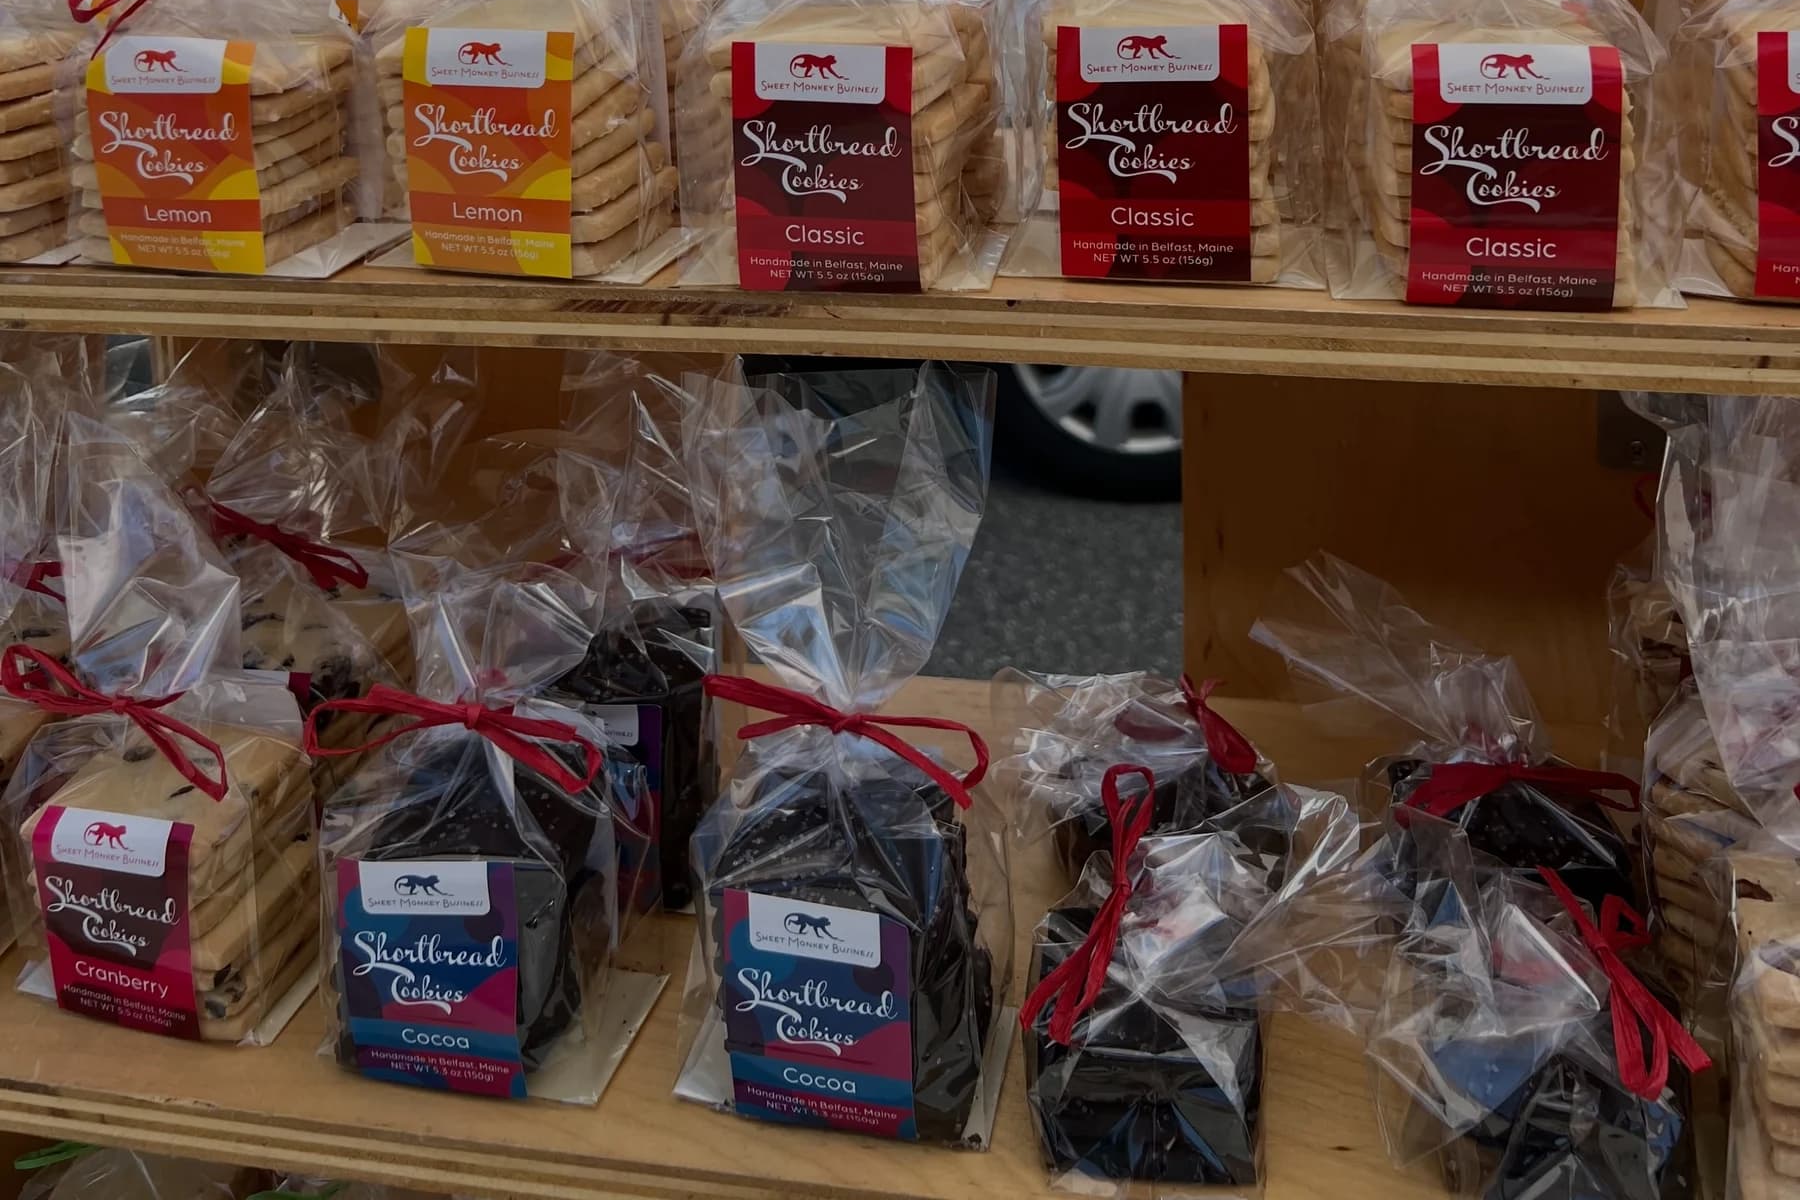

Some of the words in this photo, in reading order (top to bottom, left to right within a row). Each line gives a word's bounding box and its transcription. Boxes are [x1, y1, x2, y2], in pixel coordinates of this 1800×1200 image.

[99, 111, 239, 154] Shortbread
[413, 104, 560, 147] Shortbread
[741, 120, 901, 166] Shortbread
[1065, 102, 1238, 149] Shortbread
[136, 150, 208, 185] Cookies
[449, 145, 524, 182] Cookies
[1108, 144, 1196, 185] Cookies
[1420, 125, 1609, 175] Shortbread
[782, 163, 864, 204] Cookies
[1466, 170, 1561, 213] Cookies
[144, 205, 212, 223] Lemon
[453, 202, 522, 223] Lemon
[1110, 206, 1195, 227] Classic
[785, 224, 864, 246] Classic
[1072, 239, 1136, 250] Handmade
[1138, 242, 1149, 250] in
[1151, 242, 1196, 254] Belfast,
[1198, 243, 1234, 253] Maine
[1466, 237, 1557, 258] Classic
[750, 256, 810, 268] Handmade
[812, 258, 822, 268] in
[870, 261, 903, 272] Maine
[770, 269, 792, 278] NET
[795, 270, 814, 279] WT
[816, 271, 834, 280] 5.5
[836, 272, 849, 280] oz
[851, 272, 885, 282] (156g)
[1093, 252, 1117, 262] NET
[1120, 254, 1140, 263] WT
[1142, 254, 1160, 264] 5.5
[1162, 256, 1176, 264] oz
[1178, 256, 1214, 267] (156g)
[1422, 271, 1490, 282] Handmade
[1494, 274, 1505, 282] in
[1558, 275, 1598, 286] Maine
[1442, 284, 1470, 293] NET
[1472, 285, 1493, 294] WT
[1496, 286, 1515, 295] 5.5
[1518, 288, 1533, 296] oz
[1535, 287, 1574, 298] (156g)
[45, 876, 180, 926] Shortbread
[82, 915, 152, 958] Cookies
[353, 930, 508, 976] Shortbread
[75, 960, 168, 999] Cranberry
[391, 974, 469, 1016] Cookies
[736, 967, 898, 1019] Shortbread
[402, 1028, 470, 1050] Cocoa
[776, 1013, 859, 1057] Cookies
[372, 1050, 426, 1063] Handmade
[428, 1056, 437, 1064] in
[480, 1062, 510, 1074] Maine
[390, 1061, 411, 1070] NET
[413, 1064, 430, 1072] WT
[450, 1068, 462, 1077] oz
[783, 1067, 856, 1094] Cocoa
